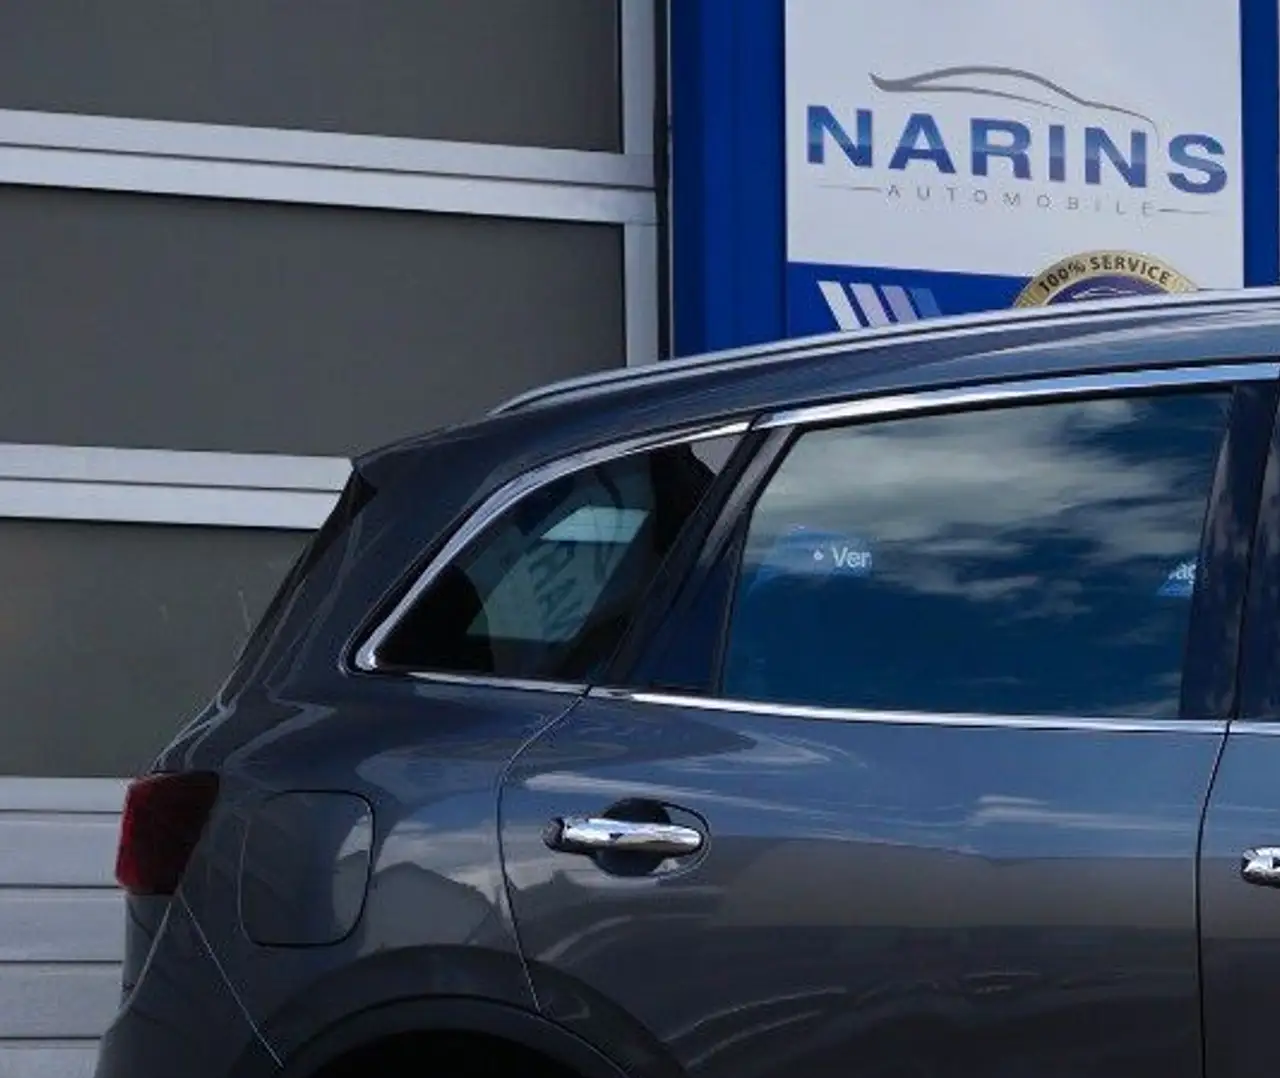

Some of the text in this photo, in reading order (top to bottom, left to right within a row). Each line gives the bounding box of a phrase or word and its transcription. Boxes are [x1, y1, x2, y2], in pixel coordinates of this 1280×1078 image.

[805, 104, 1229, 195] NARINS
[886, 185, 1157, 216] AUTOMOBILE
[1038, 255, 1173, 294] 100% SERVICE
